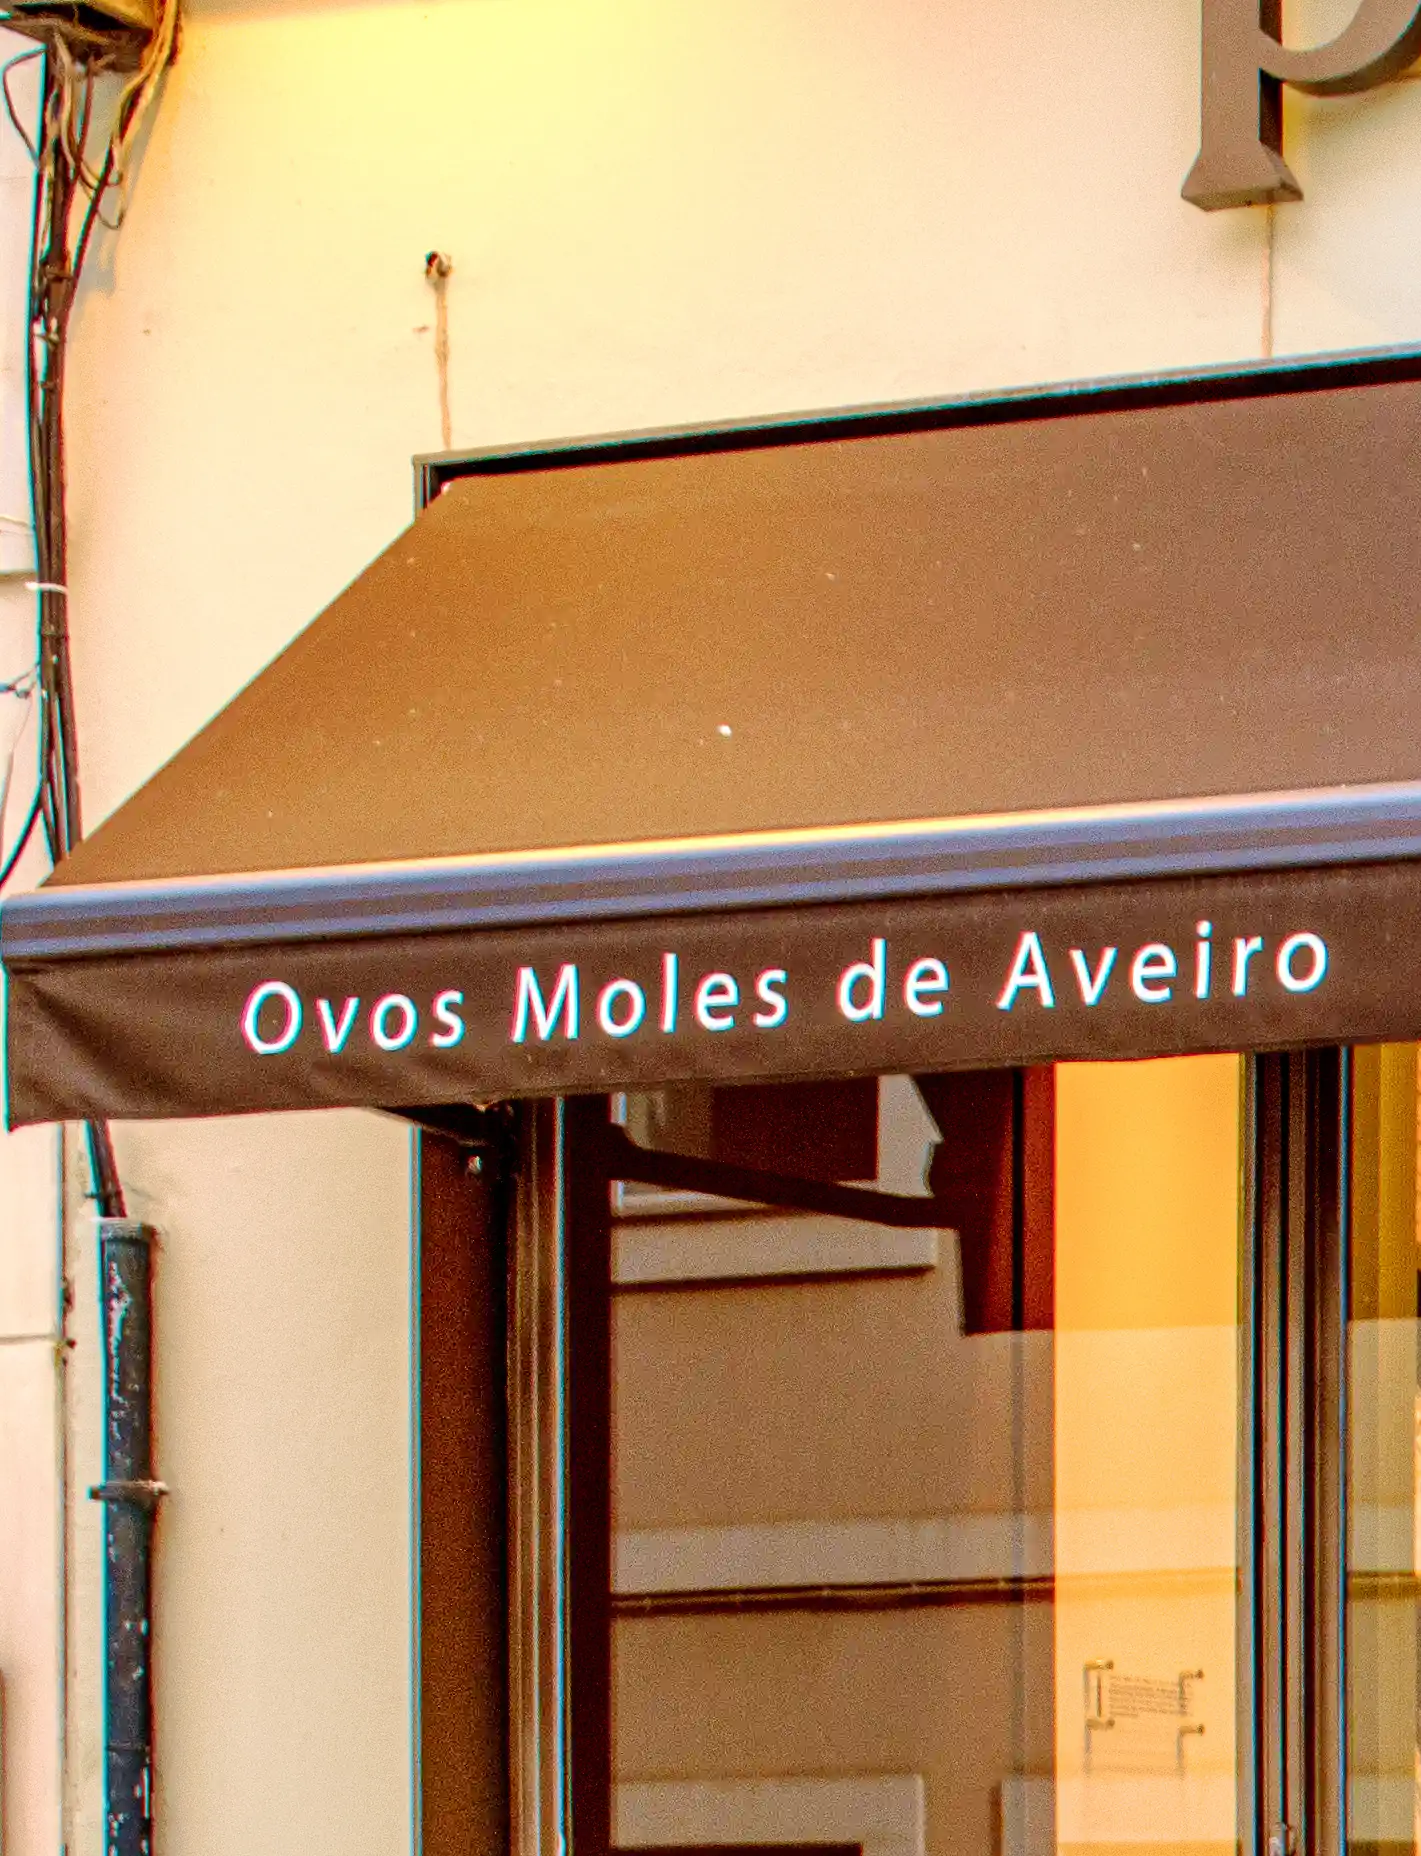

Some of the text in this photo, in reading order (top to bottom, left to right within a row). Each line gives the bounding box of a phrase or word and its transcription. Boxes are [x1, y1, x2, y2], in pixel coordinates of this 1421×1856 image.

[243, 919, 1327, 1056] Ovos Moles de Aveiro
